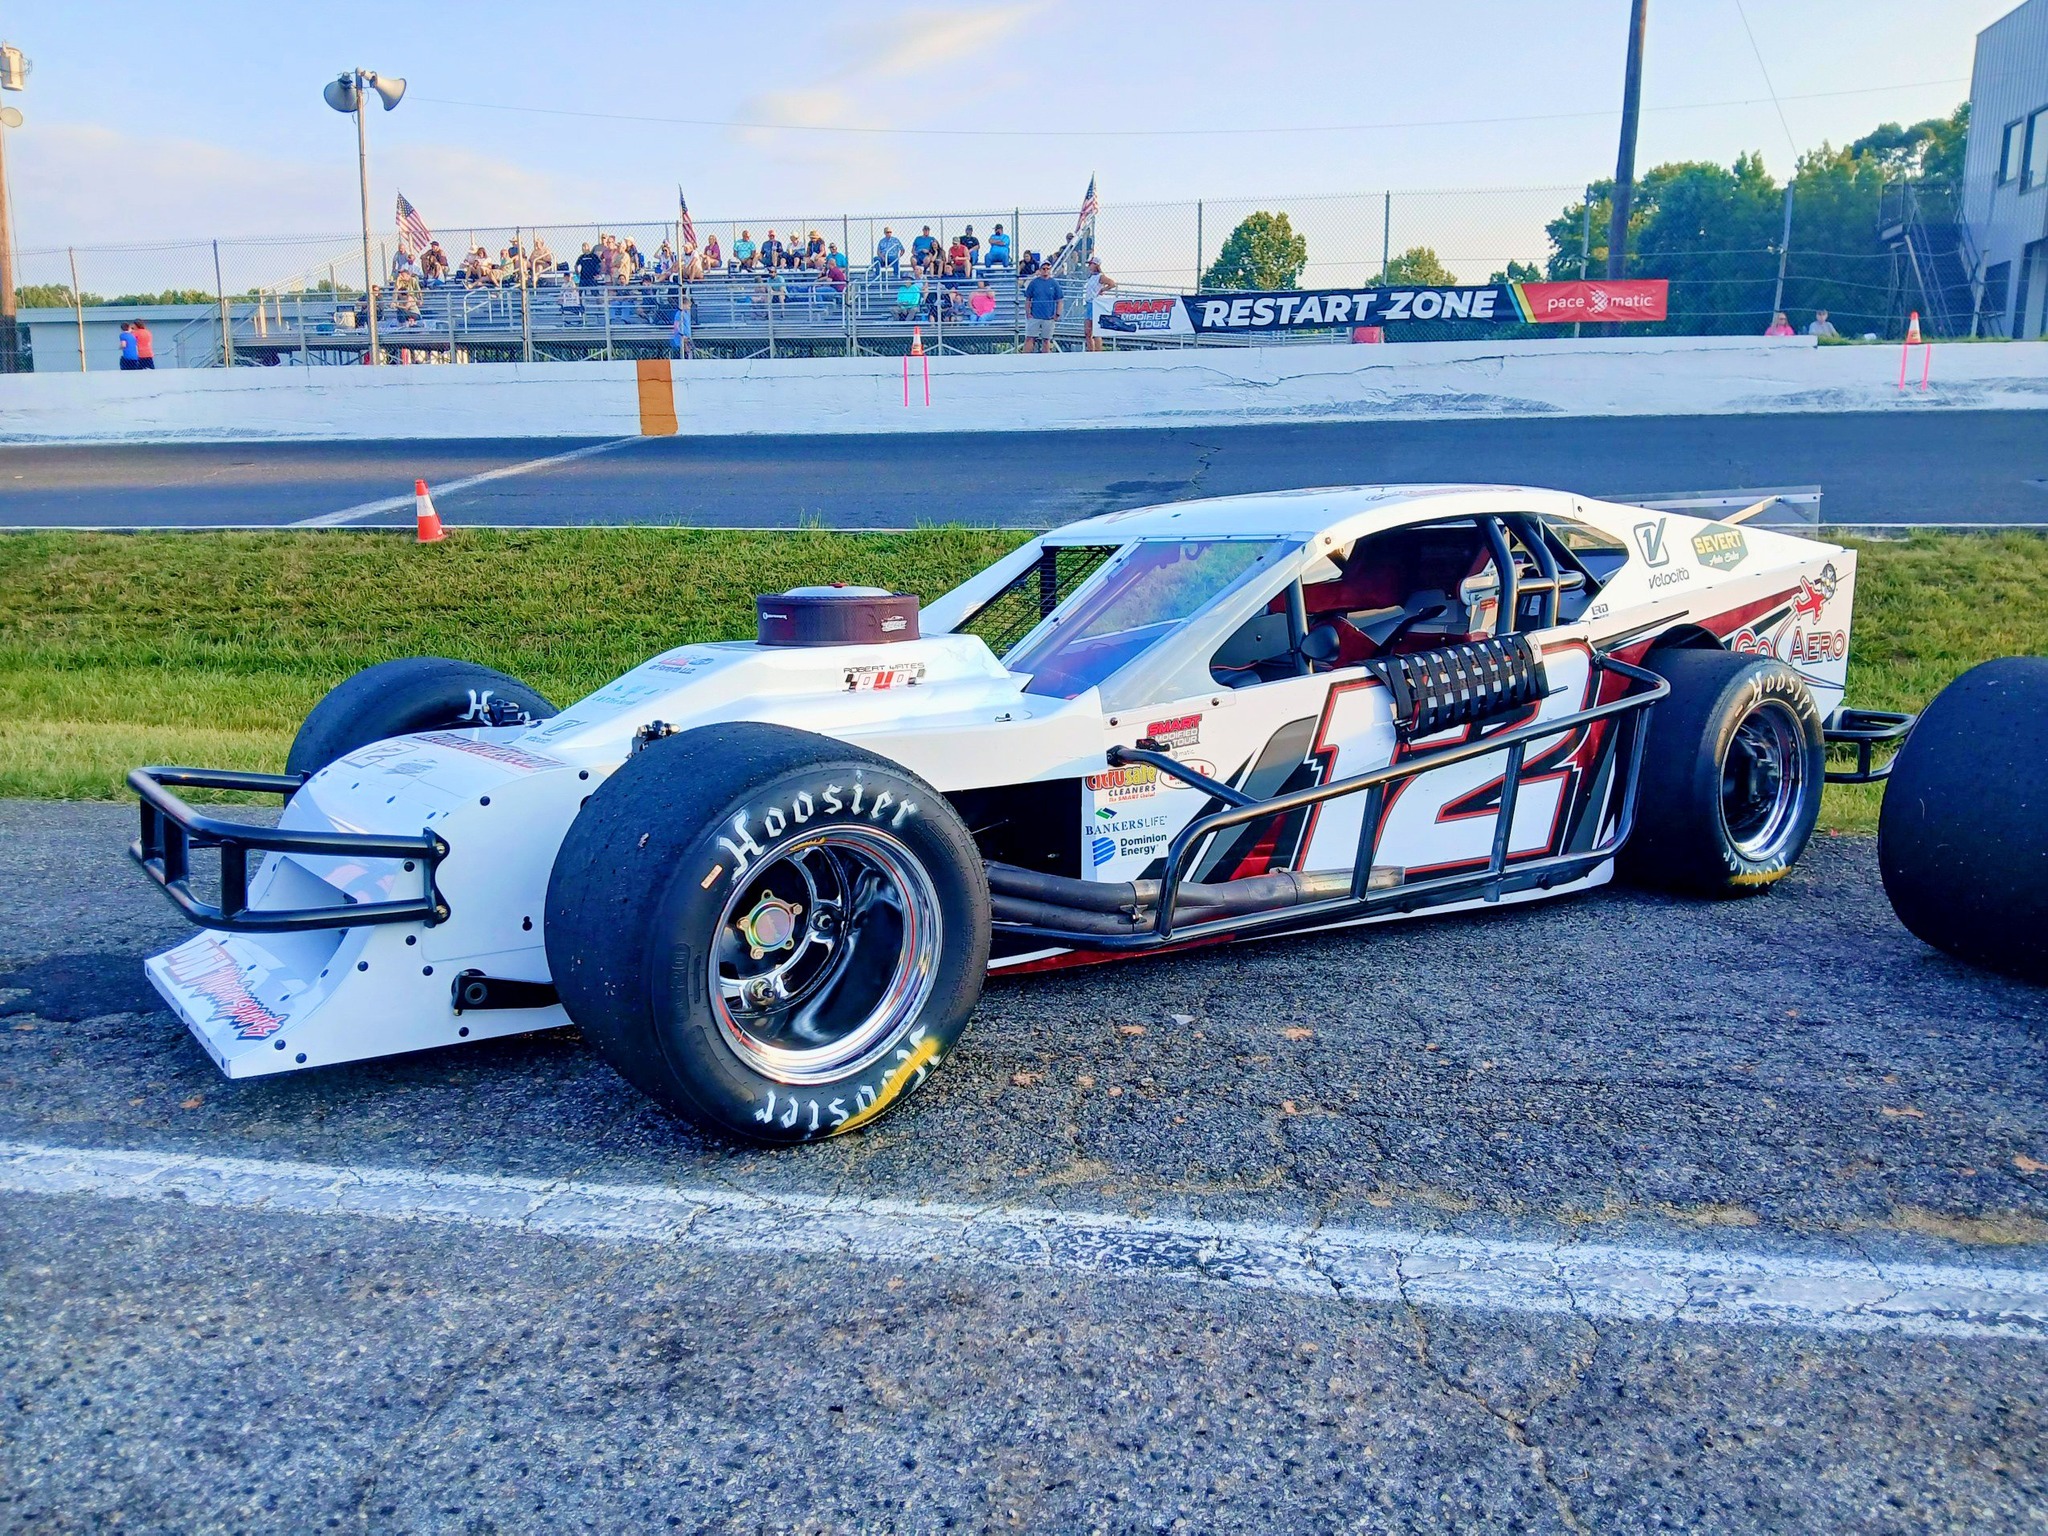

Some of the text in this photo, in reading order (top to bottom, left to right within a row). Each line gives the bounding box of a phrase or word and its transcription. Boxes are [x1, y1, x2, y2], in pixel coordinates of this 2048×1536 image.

[1113, 299, 1176, 314] SMART
[1199, 290, 1498, 328] RESTART ZONE
[1547, 293, 1653, 312] pace matic
[1121, 312, 1169, 321] MODIFIED
[1139, 320, 1168, 328] TOUR
[1693, 530, 1742, 555] SEVERT
[1788, 625, 1847, 666] AERO
[843, 664, 886, 674] ROBERT
[1748, 670, 1817, 720] Hoosier
[1146, 713, 1202, 737] SMART
[1154, 727, 1198, 743] MODIFIED
[1172, 736, 1198, 748] TOUR
[1293, 638, 1596, 877] 12
[1108, 784, 1156, 797] CLEANERS
[1118, 794, 1139, 802] SMART
[717, 769, 918, 884] Hoosier
[1120, 833, 1167, 847] Dominion
[1120, 844, 1158, 857] Energy
[753, 1024, 942, 1137] Hoosier
